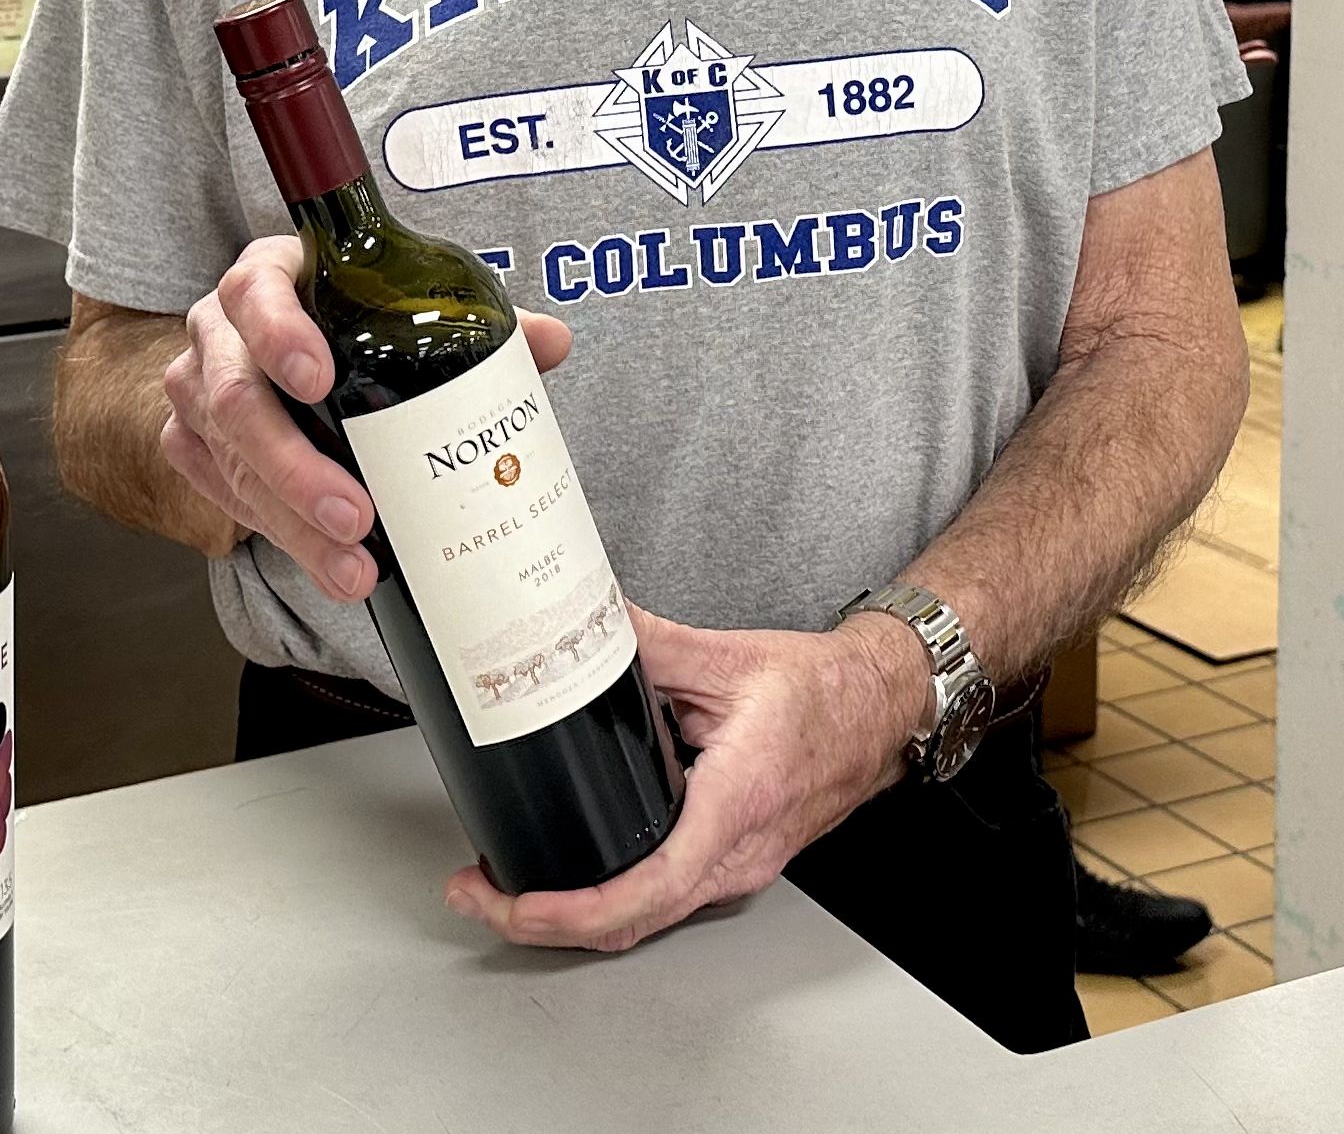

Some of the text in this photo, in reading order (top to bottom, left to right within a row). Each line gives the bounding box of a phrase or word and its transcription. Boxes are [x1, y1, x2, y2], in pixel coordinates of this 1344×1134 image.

[642, 62, 728, 95] K OF C
[817, 75, 917, 119] 1882
[457, 114, 554, 162] EST.
[542, 195, 966, 307] COLUMBUS
[423, 392, 540, 480] NORTON
[441, 468, 573, 562] BARREL SELECT
[518, 544, 566, 582] MALBEC
